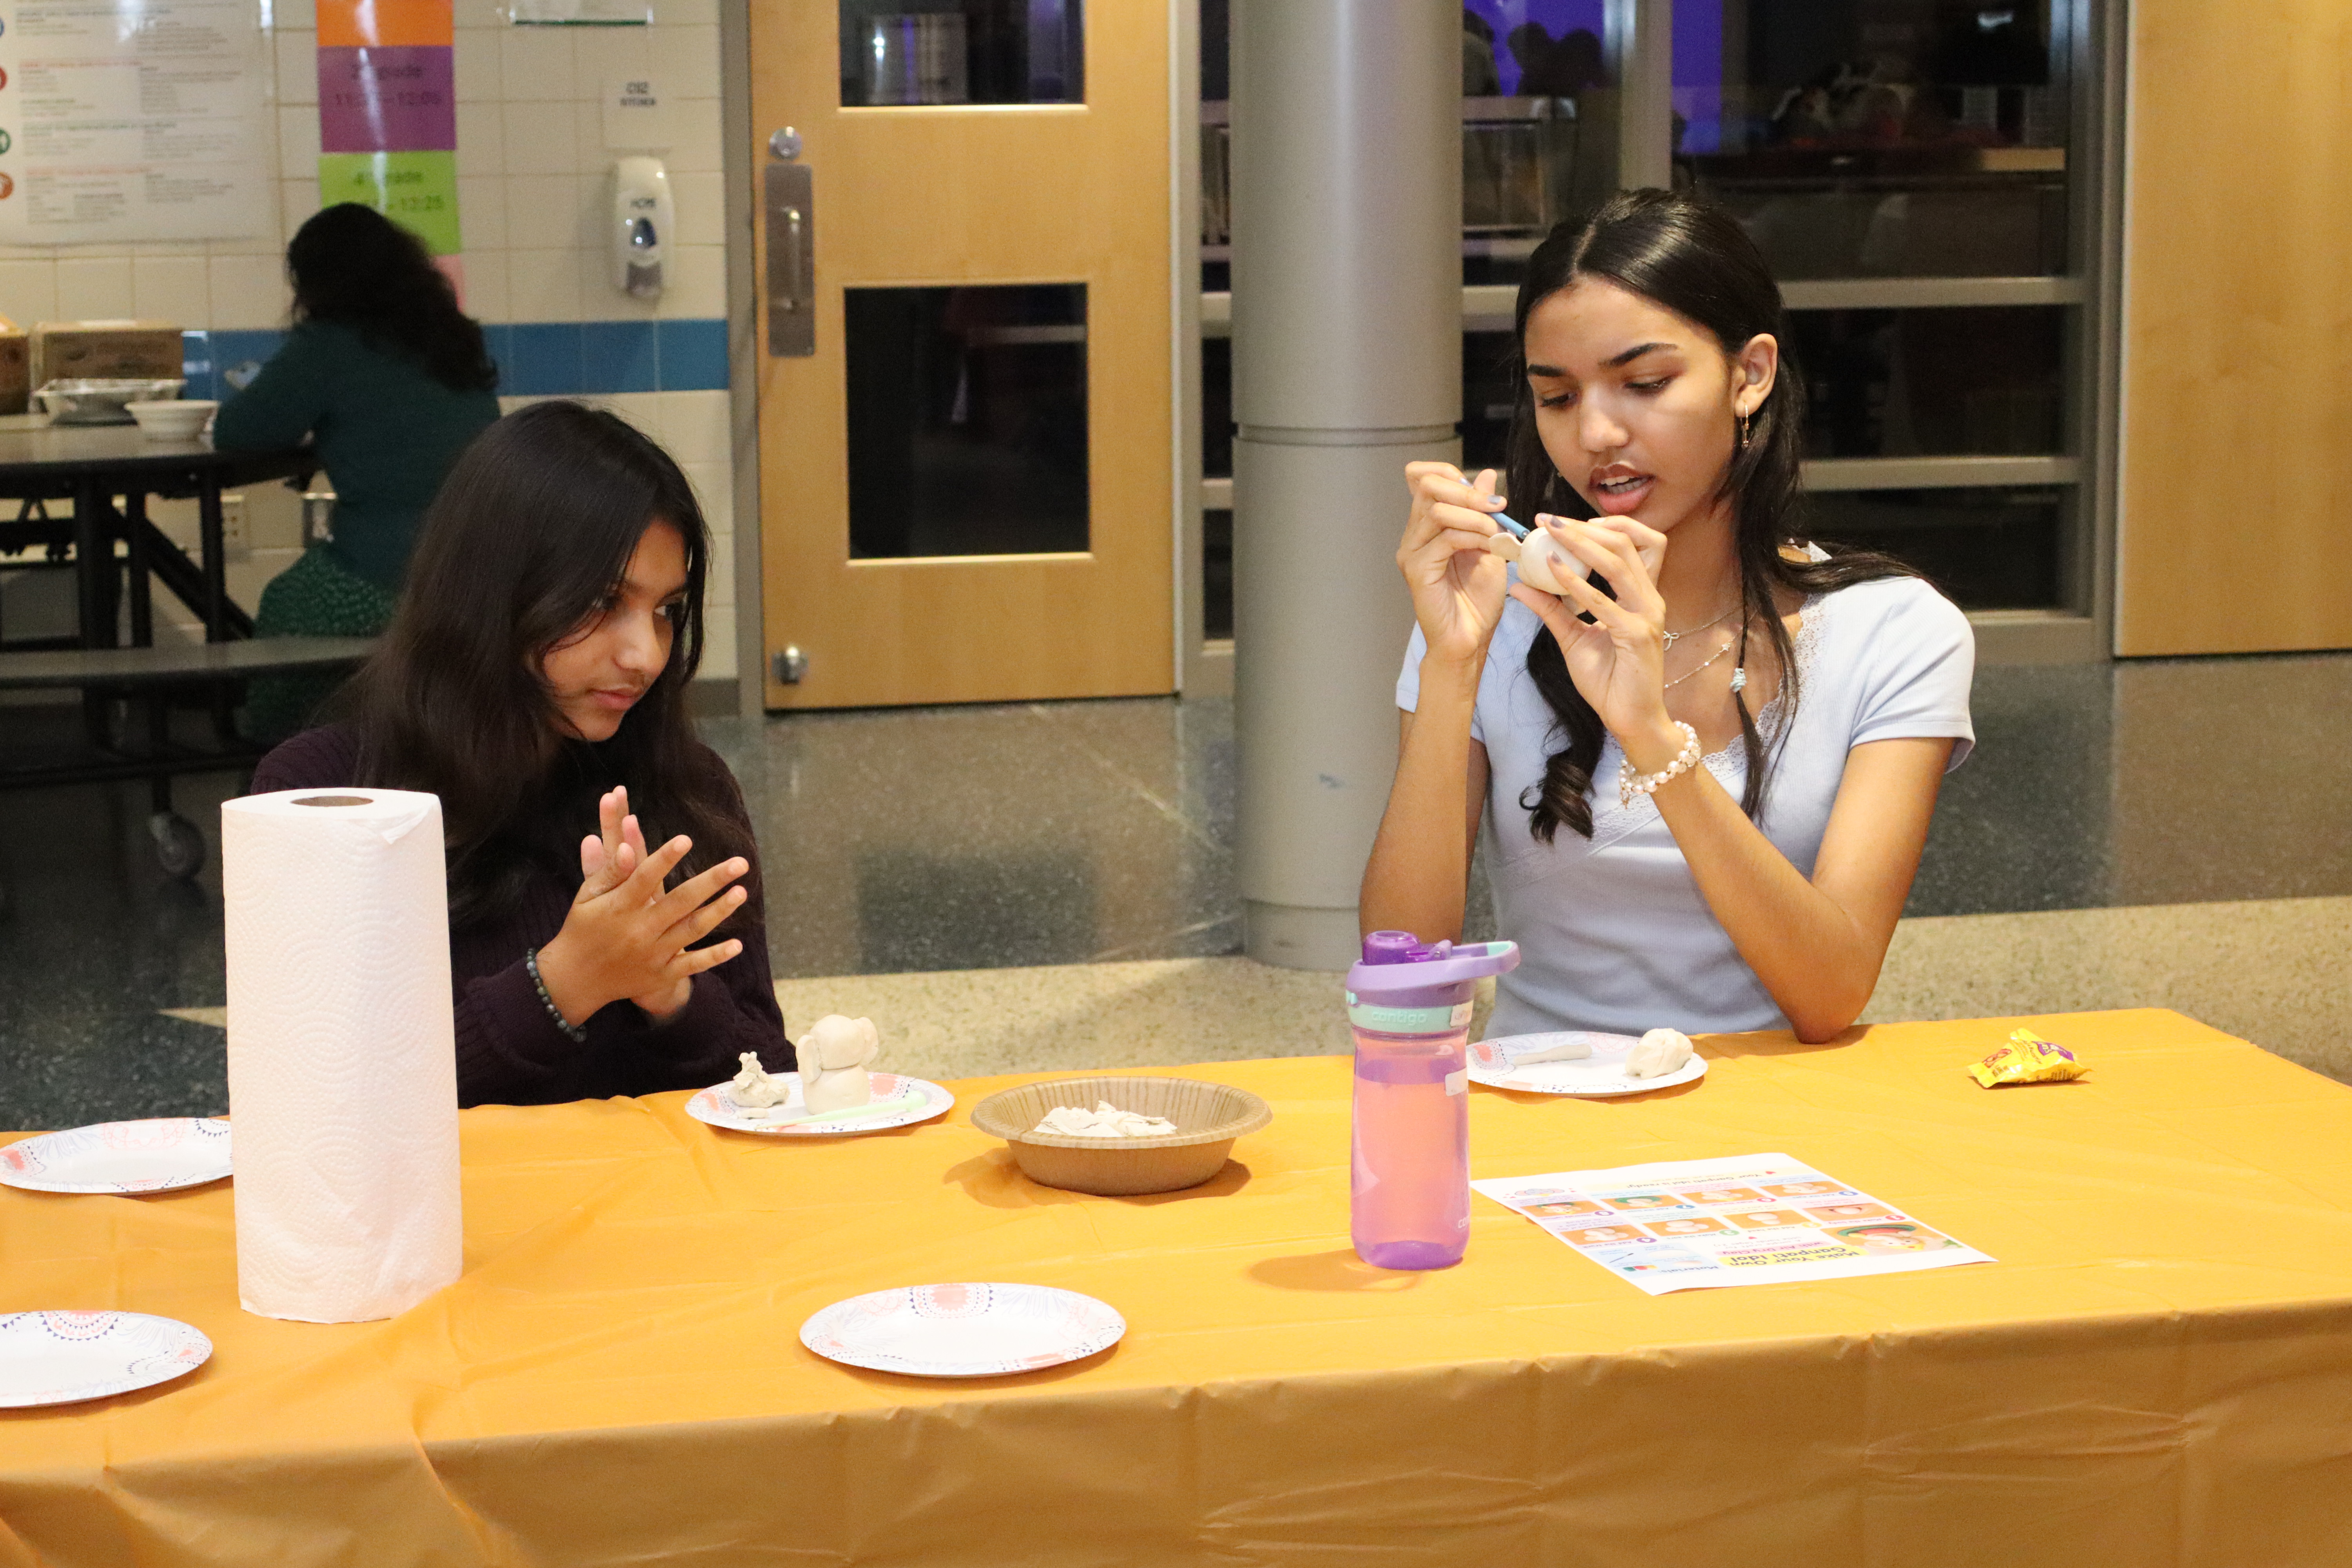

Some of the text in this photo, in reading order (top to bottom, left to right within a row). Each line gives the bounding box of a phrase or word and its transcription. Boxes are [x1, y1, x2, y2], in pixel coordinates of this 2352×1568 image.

[1371, 1010, 1428, 1026] contigo
[1771, 1246, 1845, 1258] Ganpati
[1817, 1251, 1860, 1259] Make
